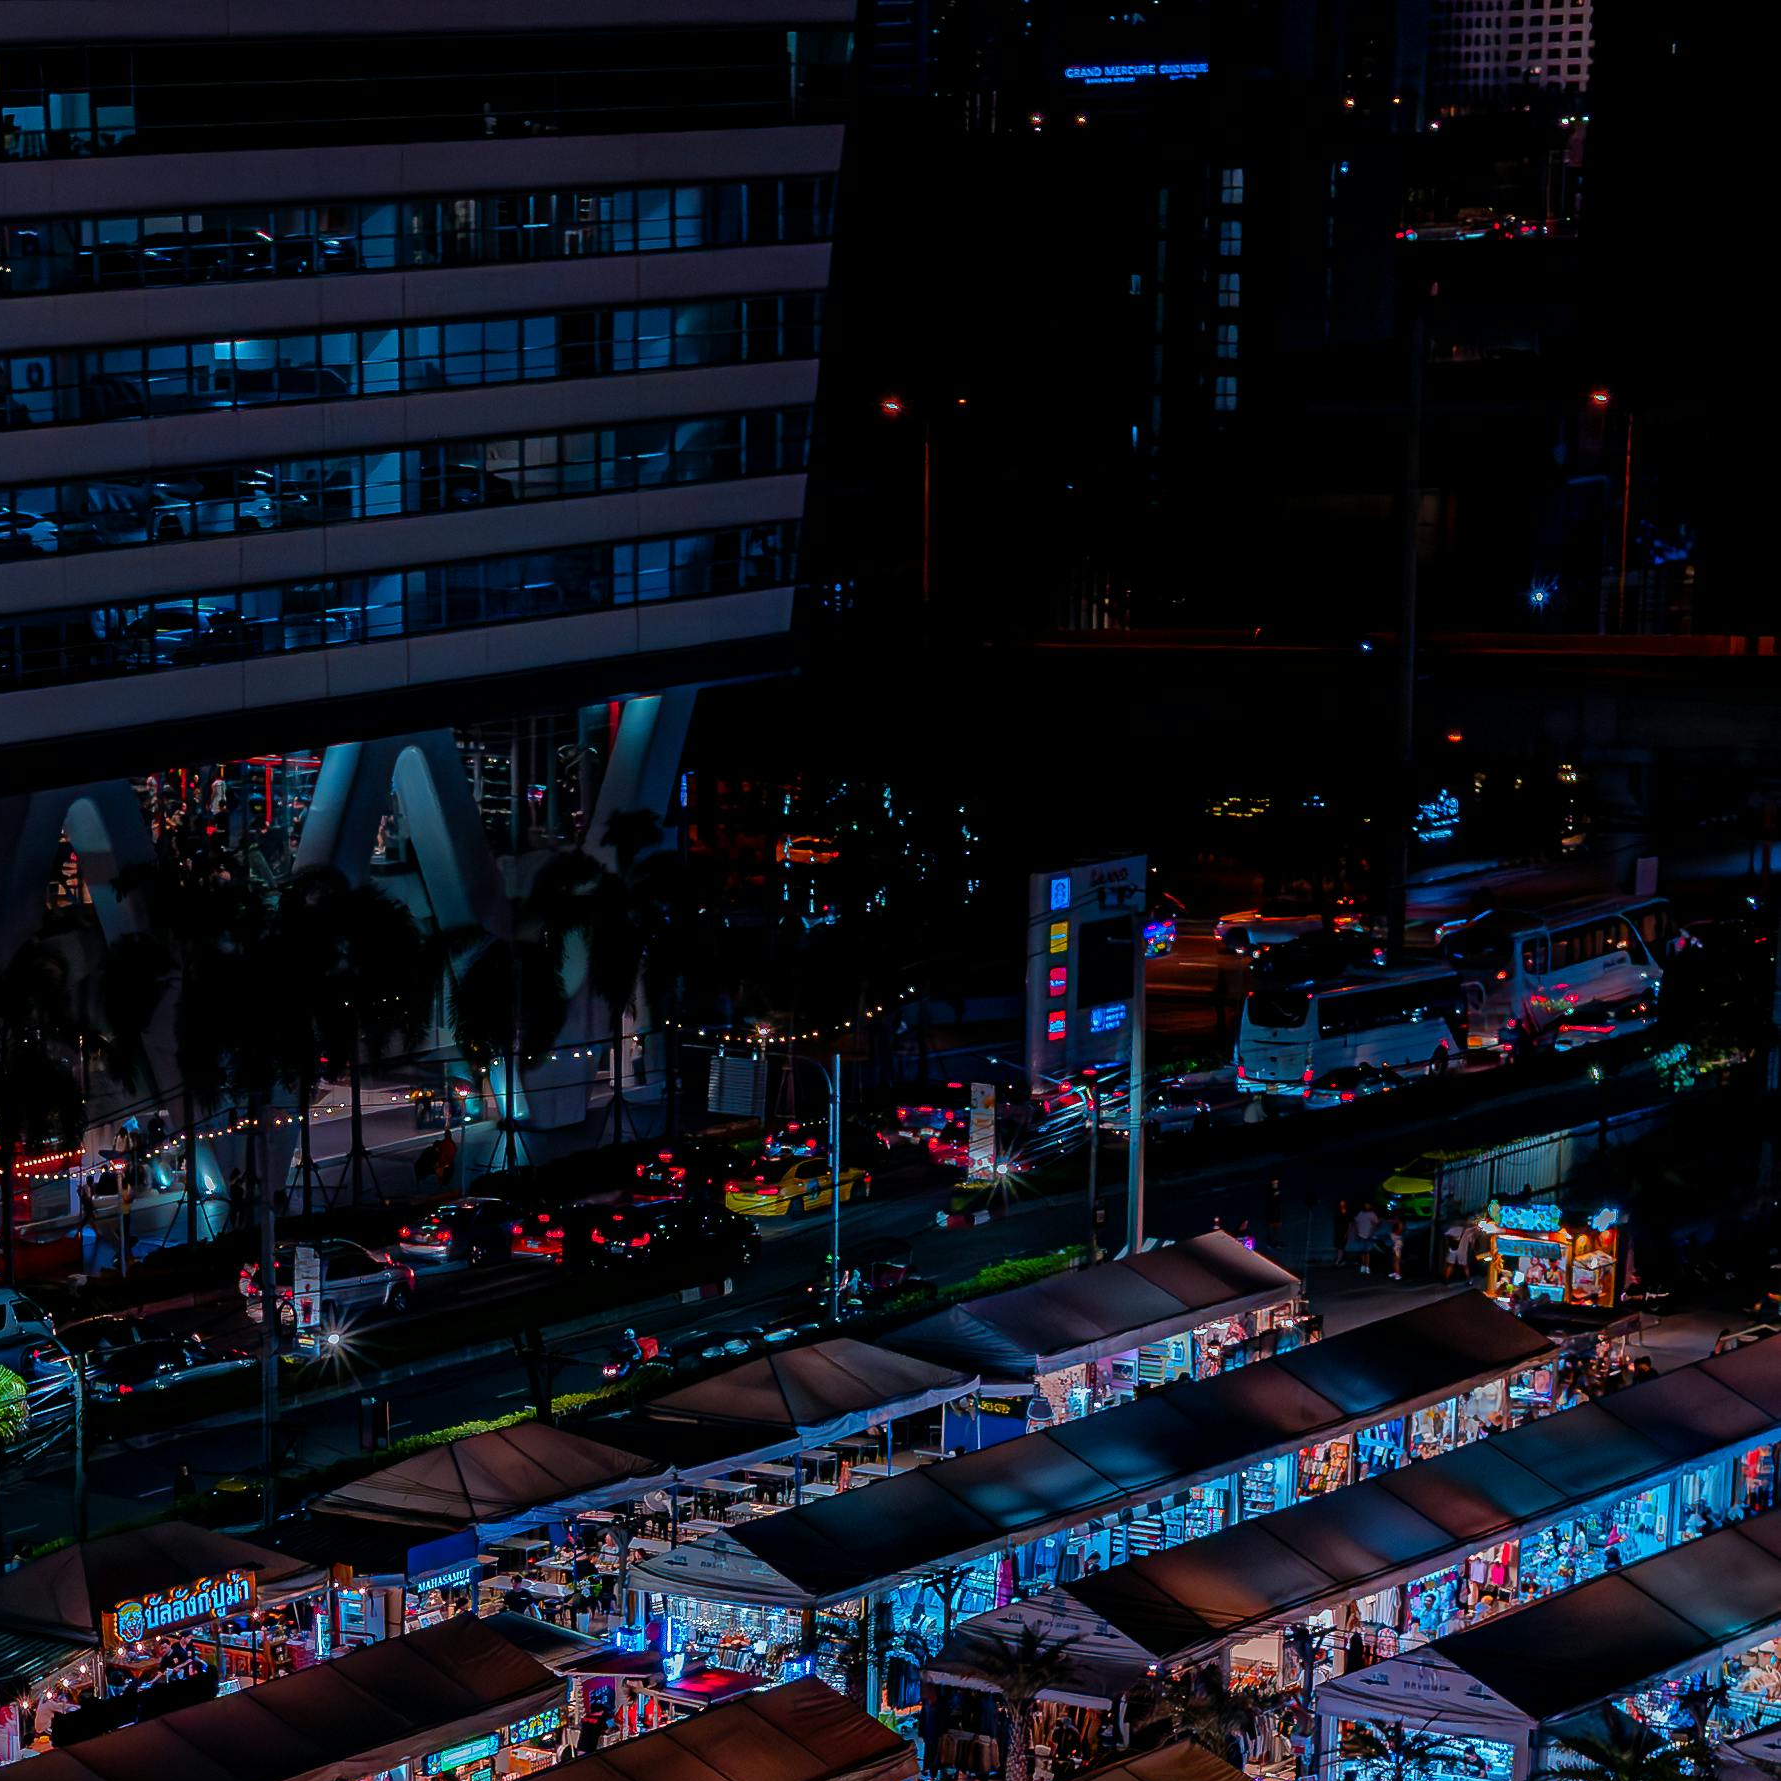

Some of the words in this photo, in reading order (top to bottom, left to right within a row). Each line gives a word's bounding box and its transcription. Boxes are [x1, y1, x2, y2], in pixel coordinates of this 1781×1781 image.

[144, 1572, 249, 1630] บัลลังก์ปูม้า
